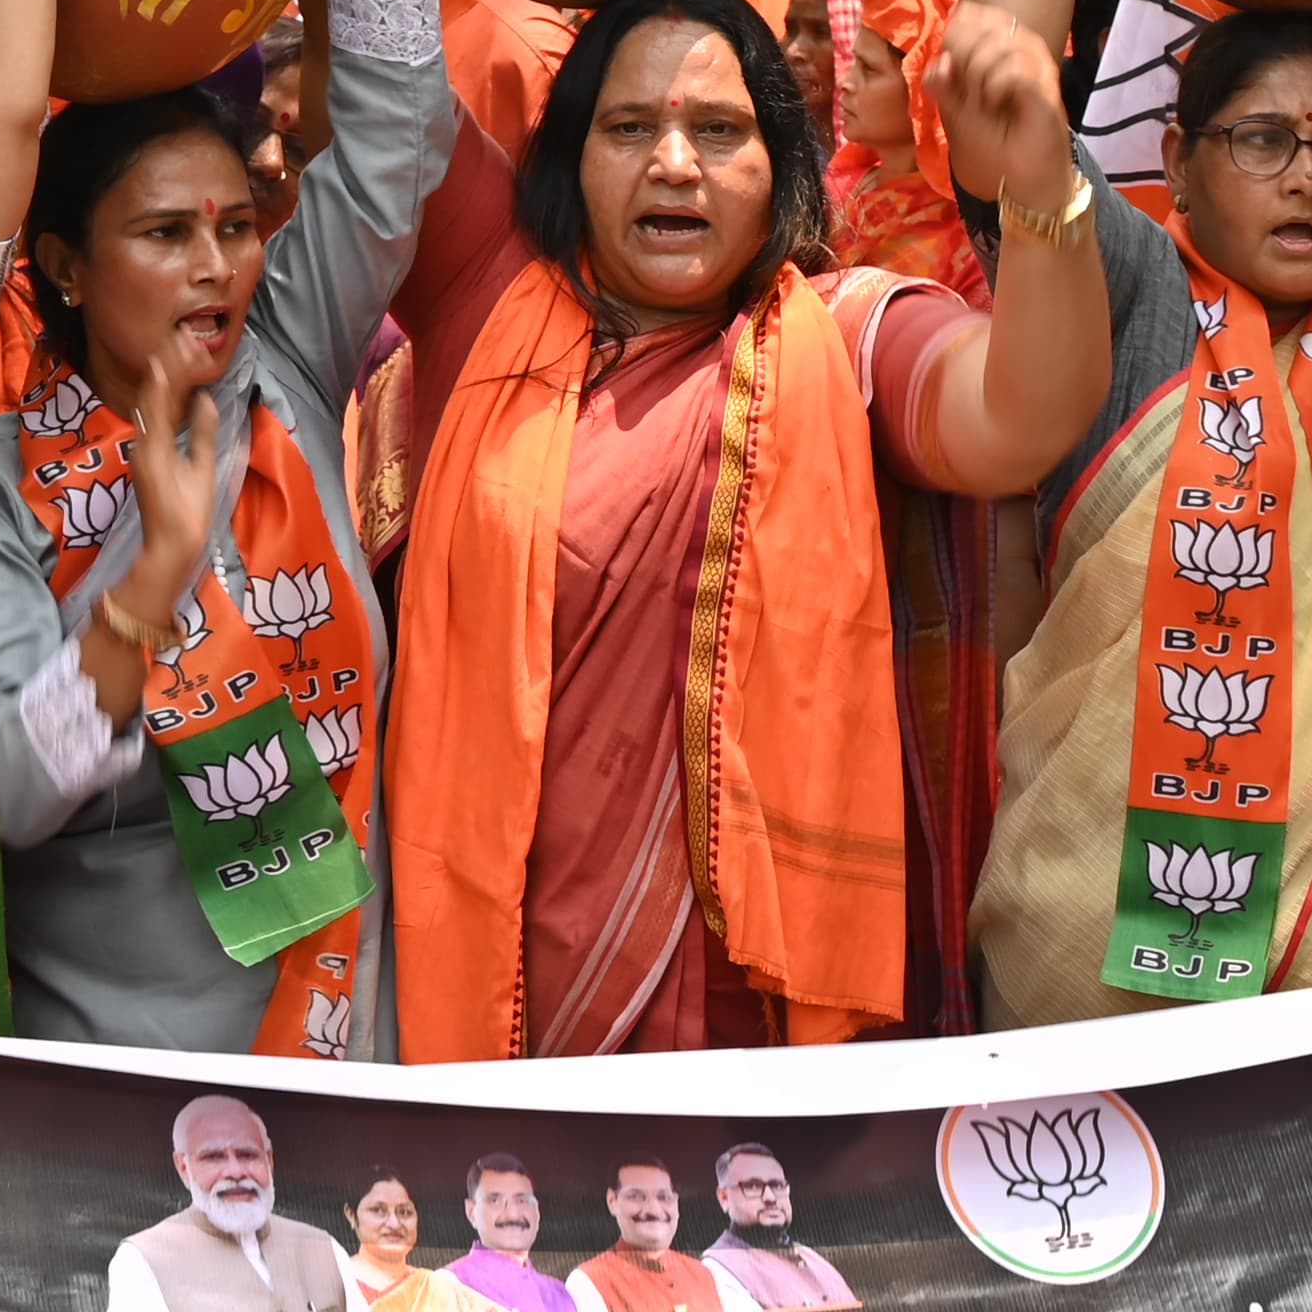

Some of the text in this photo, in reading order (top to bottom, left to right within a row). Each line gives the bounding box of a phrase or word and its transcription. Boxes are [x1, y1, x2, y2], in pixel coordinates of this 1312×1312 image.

[1175, 487, 1279, 516] BJP
[1161, 626, 1277, 663] BJP
[145, 669, 260, 736] BJP
[1150, 773, 1272, 809] BJP
[215, 827, 336, 892] BJP
[1130, 944, 1254, 983] BJP
